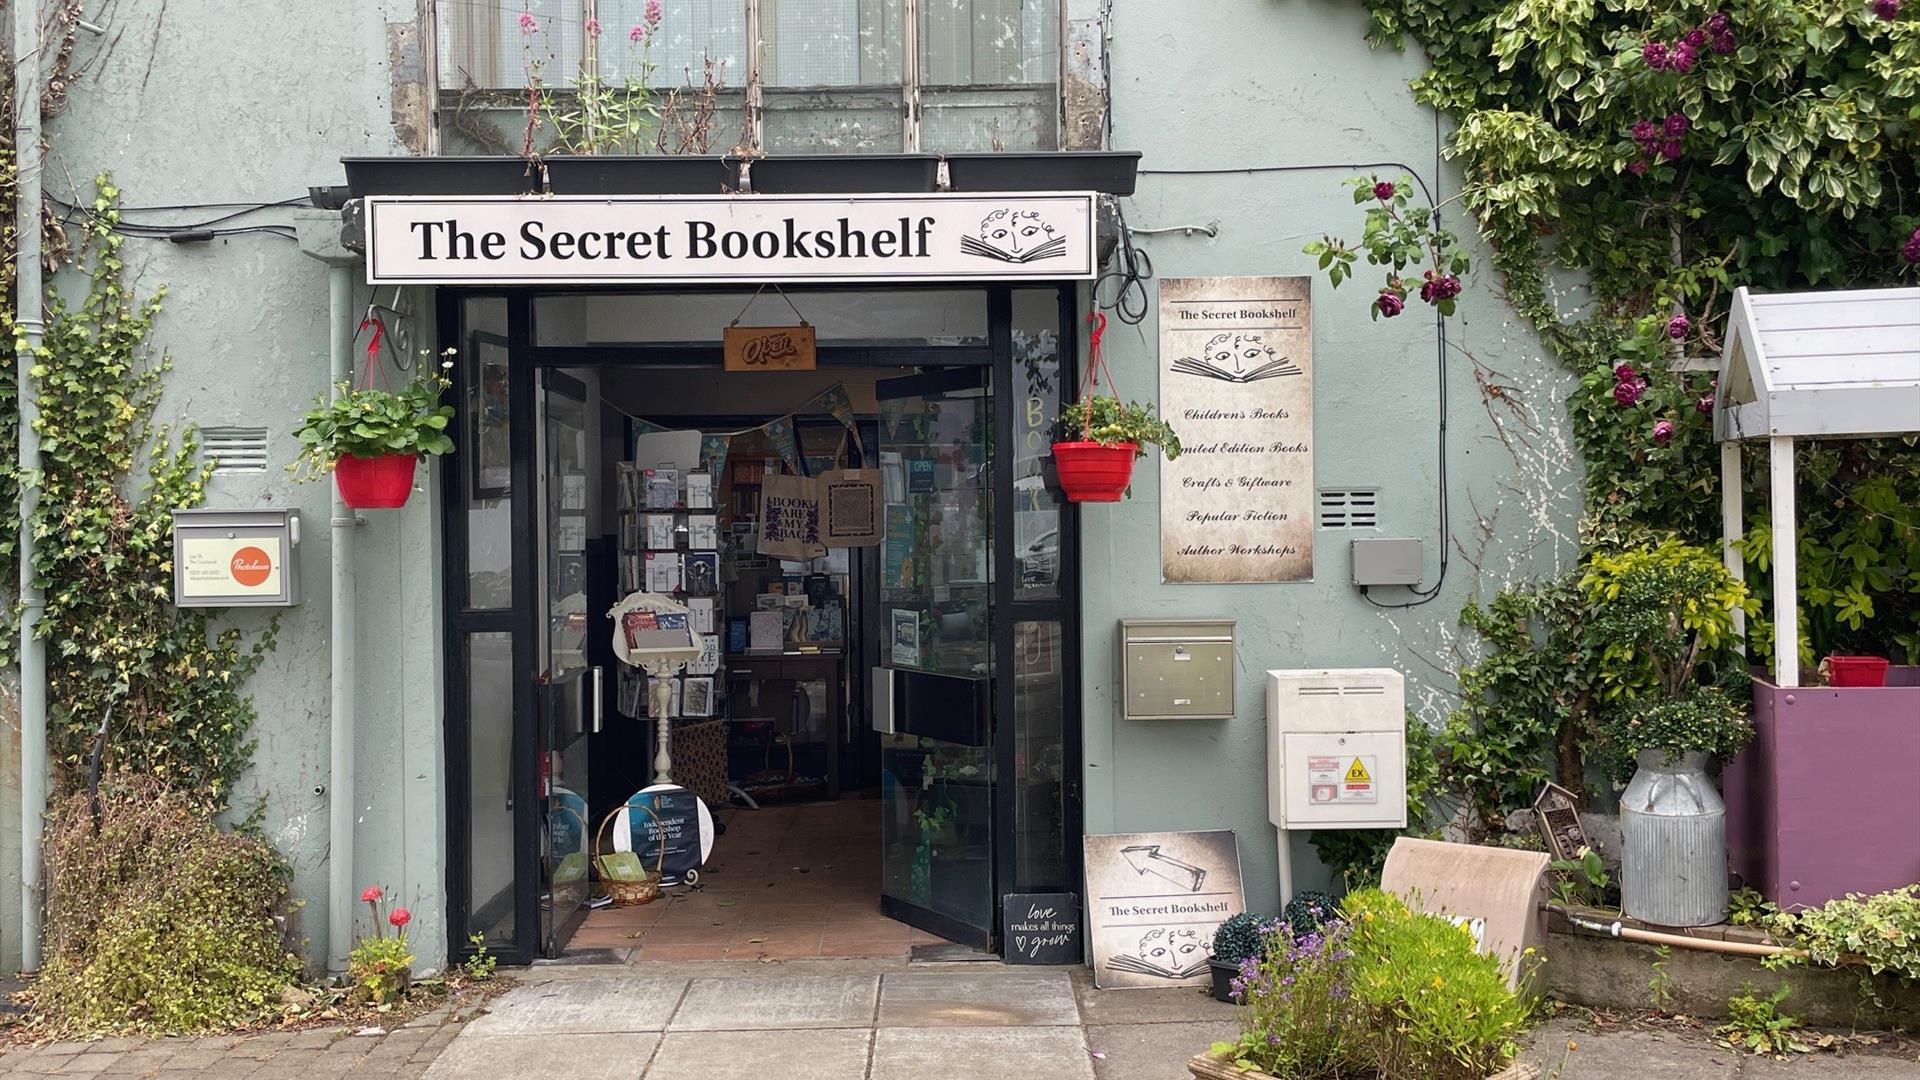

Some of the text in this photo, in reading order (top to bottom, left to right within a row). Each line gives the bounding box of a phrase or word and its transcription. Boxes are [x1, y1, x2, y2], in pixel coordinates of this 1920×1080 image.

[410, 216, 936, 260] The Secret Bookshelf
[1178, 308, 1297, 320] The Secret Bookshelf
[1250, 407, 1290, 420] Books
[1180, 441, 1308, 455] mited Edition Books
[914, 460, 932, 472] OPEN
[1182, 475, 1292, 492] Crafts & Giftware
[781, 508, 806, 519] ARE
[1186, 509, 1288, 525] Popular Fiction
[784, 518, 803, 529] MY
[1177, 543, 1296, 558] Author Workshops
[1352, 769, 1364, 778] EX
[667, 831, 682, 840] Year
[1027, 903, 1057, 920] love
[1109, 902, 1229, 916] The Secret Bookshelf
[1010, 920, 1075, 933] makes all things
[1030, 935, 1072, 958] grow
